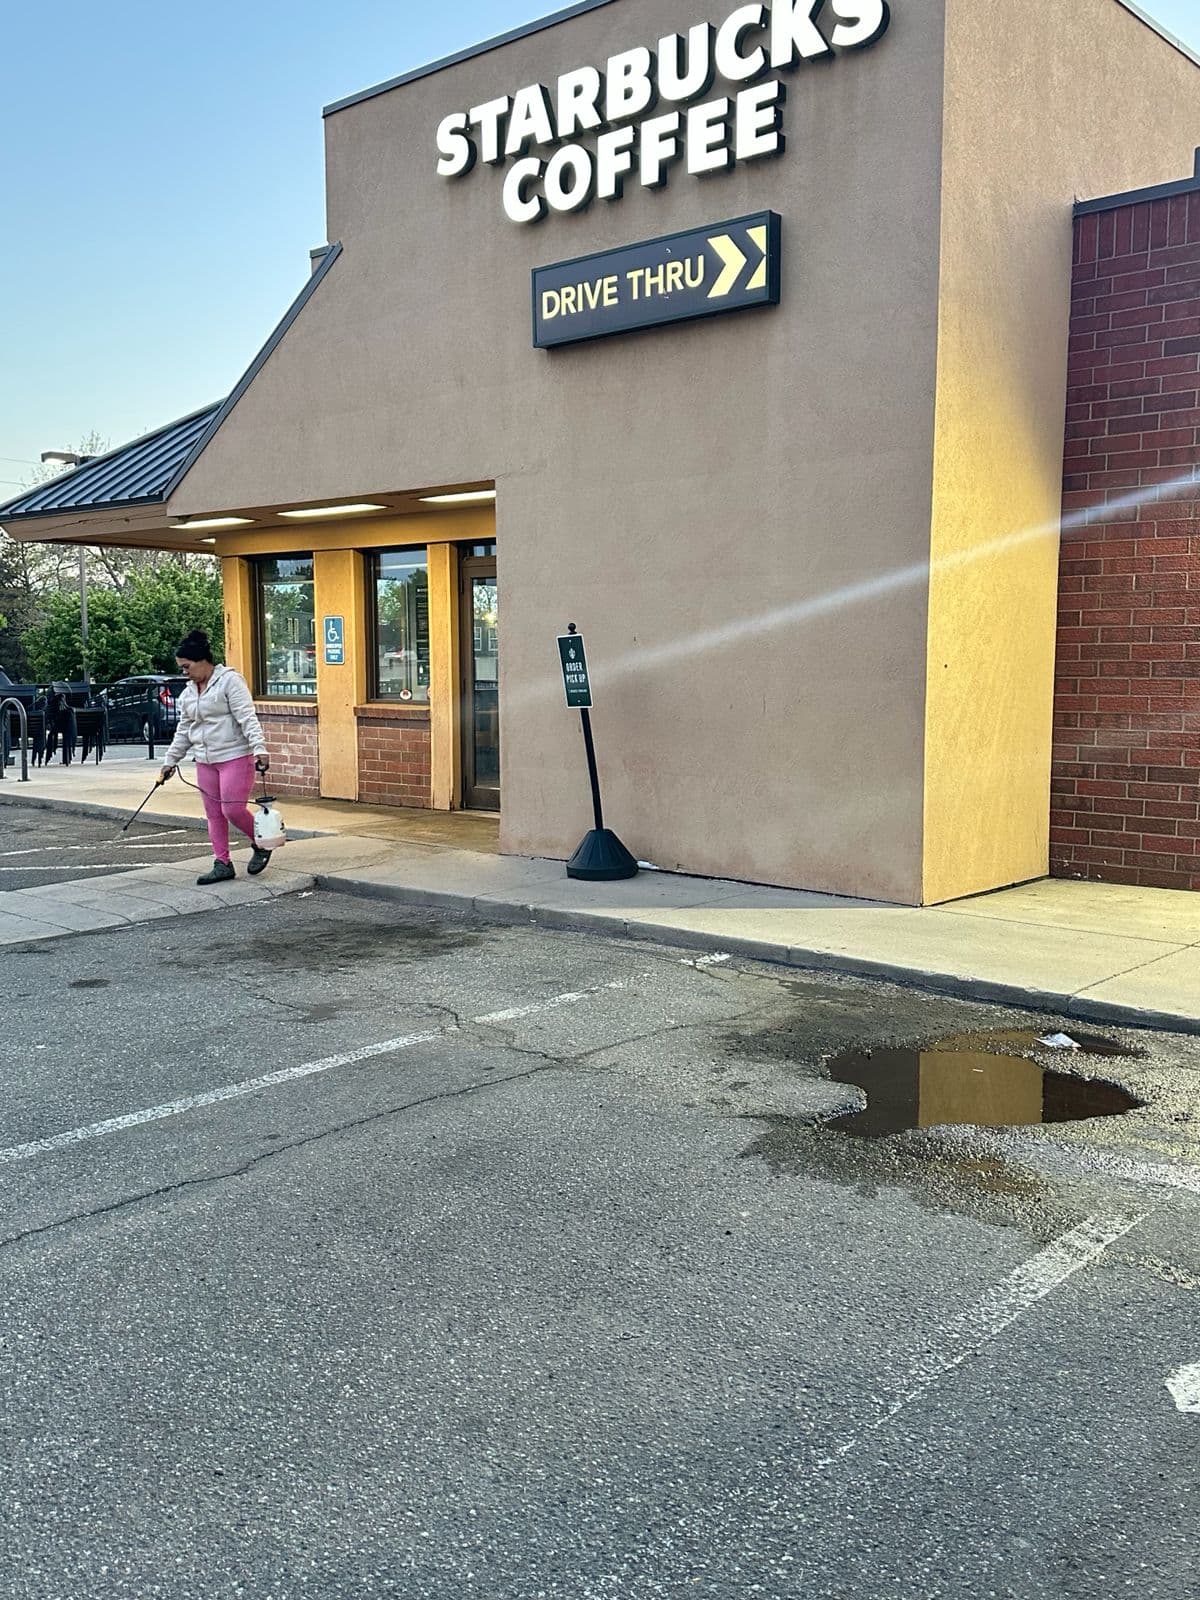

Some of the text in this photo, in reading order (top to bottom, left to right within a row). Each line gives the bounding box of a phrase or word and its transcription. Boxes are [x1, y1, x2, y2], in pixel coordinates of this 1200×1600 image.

[436, 0, 886, 177] STARBUCKS
[502, 79, 780, 223] COFFEE
[541, 255, 705, 320] DRIVE THRU
[565, 662, 583, 672] ORDER
[578, 673, 586, 683] UP
